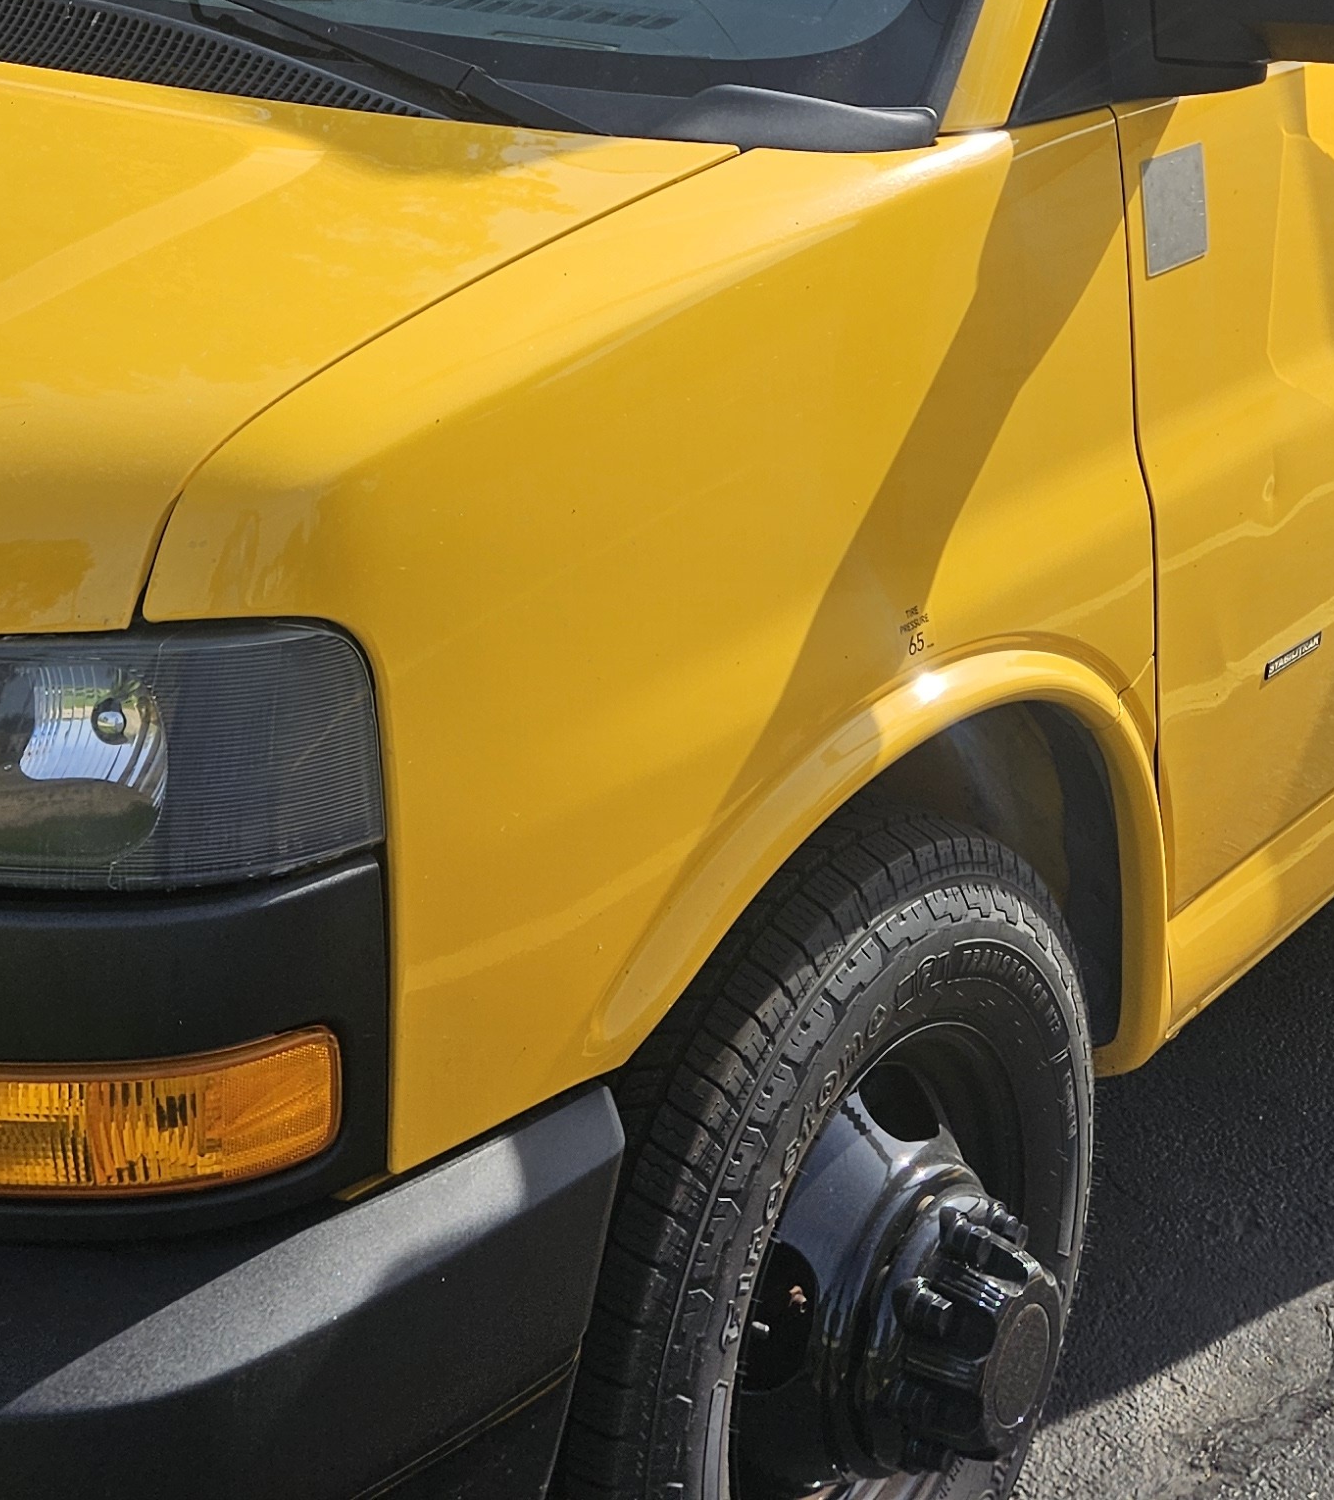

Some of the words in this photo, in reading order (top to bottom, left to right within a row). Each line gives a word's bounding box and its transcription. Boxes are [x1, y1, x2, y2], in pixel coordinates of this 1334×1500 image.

[900, 613, 929, 635] PRESSURE
[908, 631, 925, 656] 65
[960, 948, 1050, 1011] TRANSFORCE
